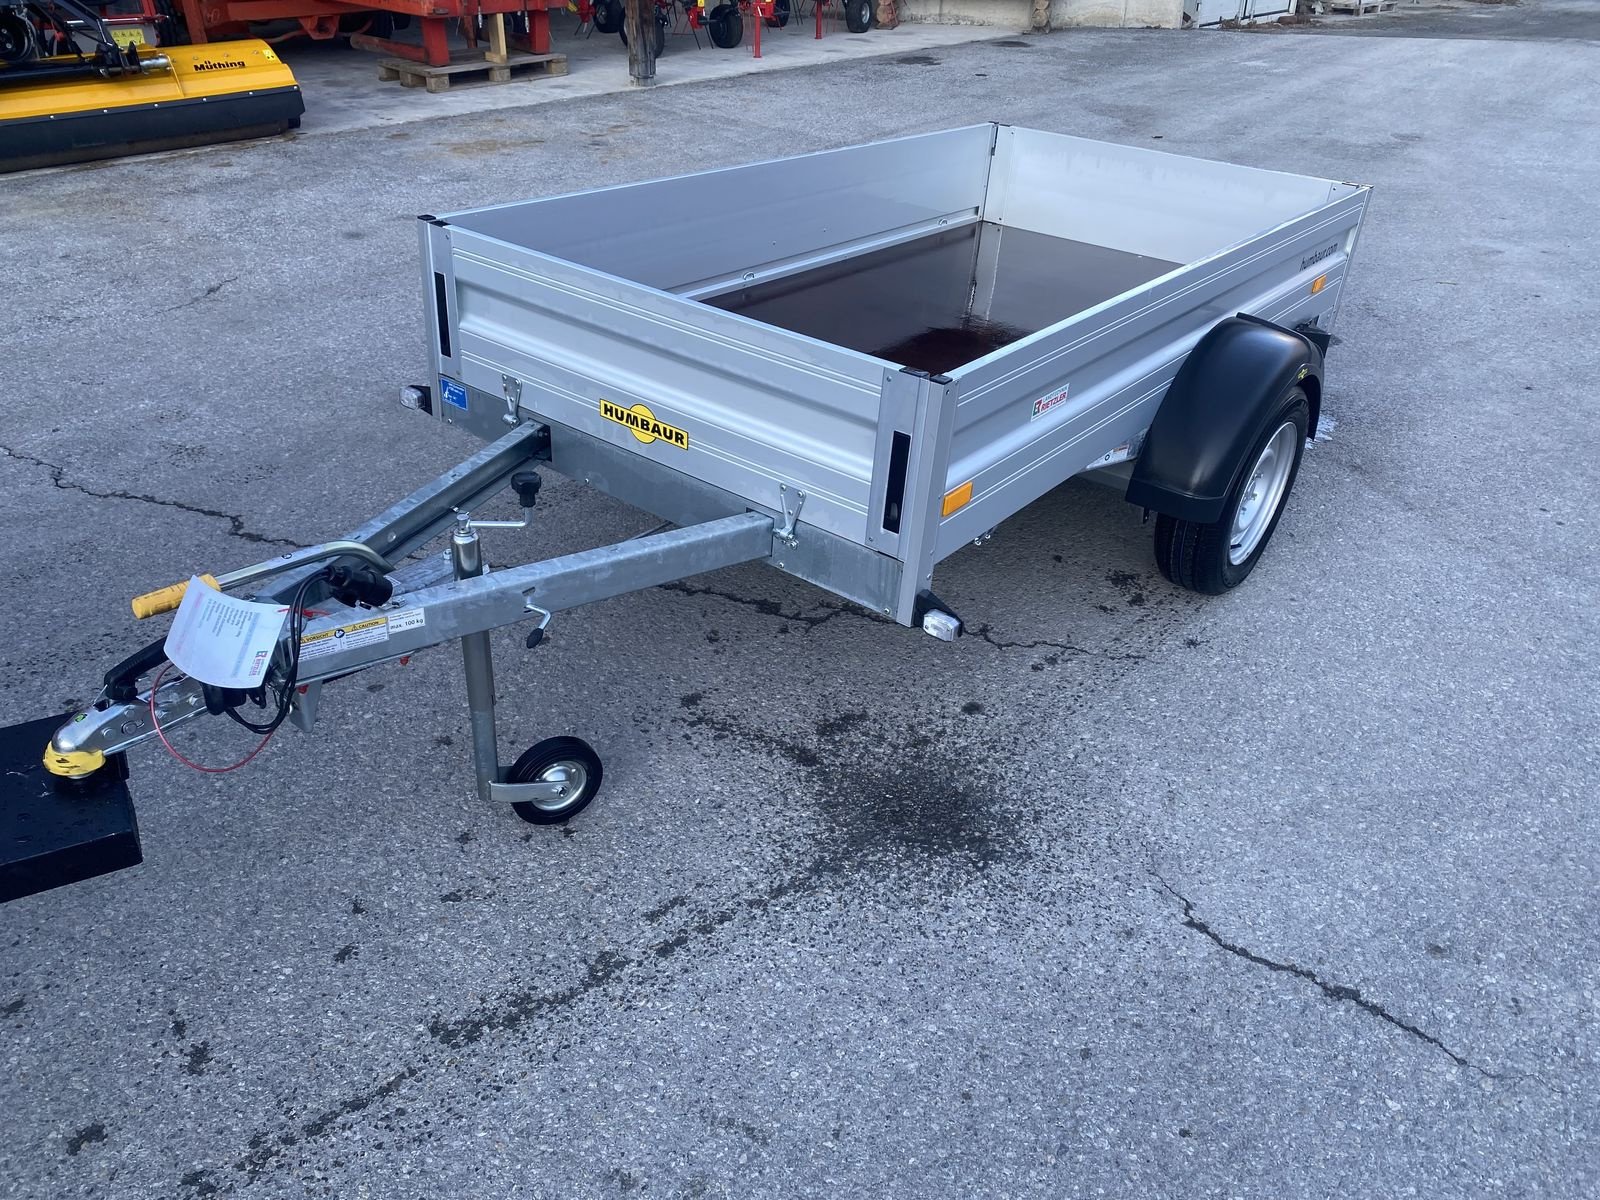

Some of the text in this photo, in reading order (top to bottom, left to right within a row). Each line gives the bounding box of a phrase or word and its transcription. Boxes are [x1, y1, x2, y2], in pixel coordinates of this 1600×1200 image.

[193, 60, 246, 71] Müthing
[1299, 242, 1338, 272] humbaur.com
[1041, 392, 1067, 411] RIETZLER
[603, 403, 685, 446] HUMBAUR
[358, 621, 379, 629] CAUTION
[305, 633, 330, 643] VORSICHT
